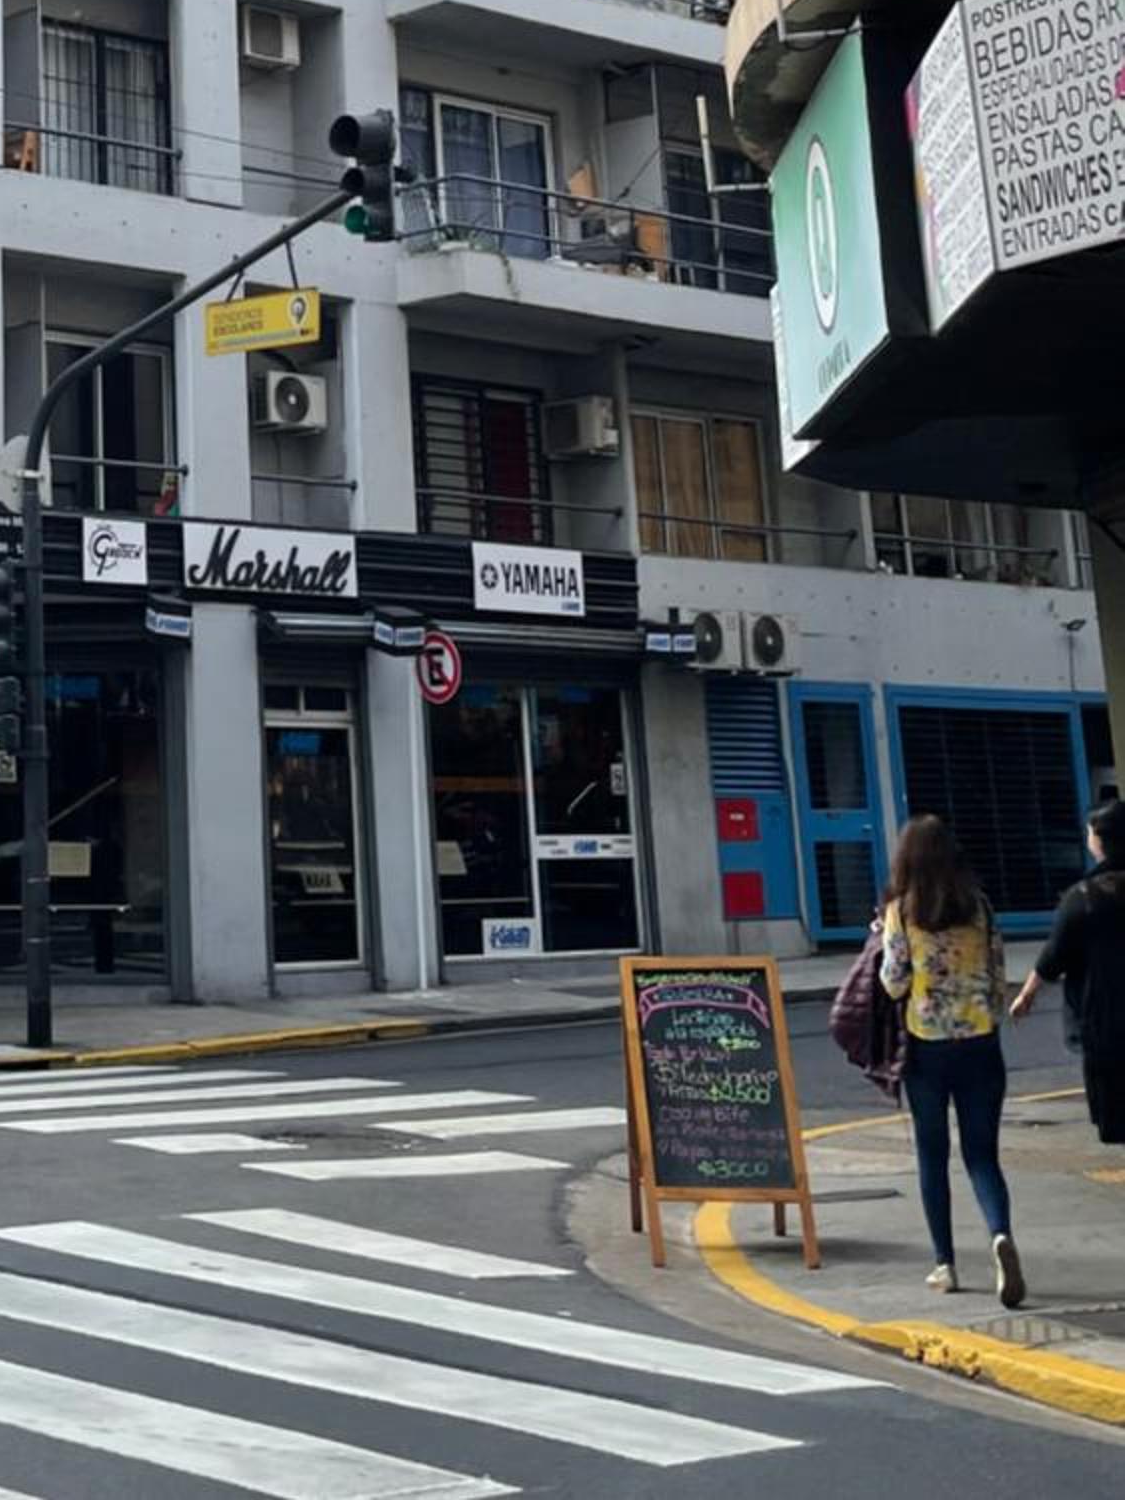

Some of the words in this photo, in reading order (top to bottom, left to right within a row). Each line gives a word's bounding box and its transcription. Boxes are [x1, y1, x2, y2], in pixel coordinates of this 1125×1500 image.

[973, 0, 1094, 80] BEBIDAS
[979, 41, 1108, 112] ESPECIALIDADES
[987, 74, 1114, 145] ENSALADAS
[992, 122, 1084, 179] PASTAS
[996, 151, 1113, 223] SANDWICHES
[1001, 202, 1102, 258] ENTRADAS
[187, 526, 352, 594] Marshall
[500, 561, 580, 598] YAMAHA
